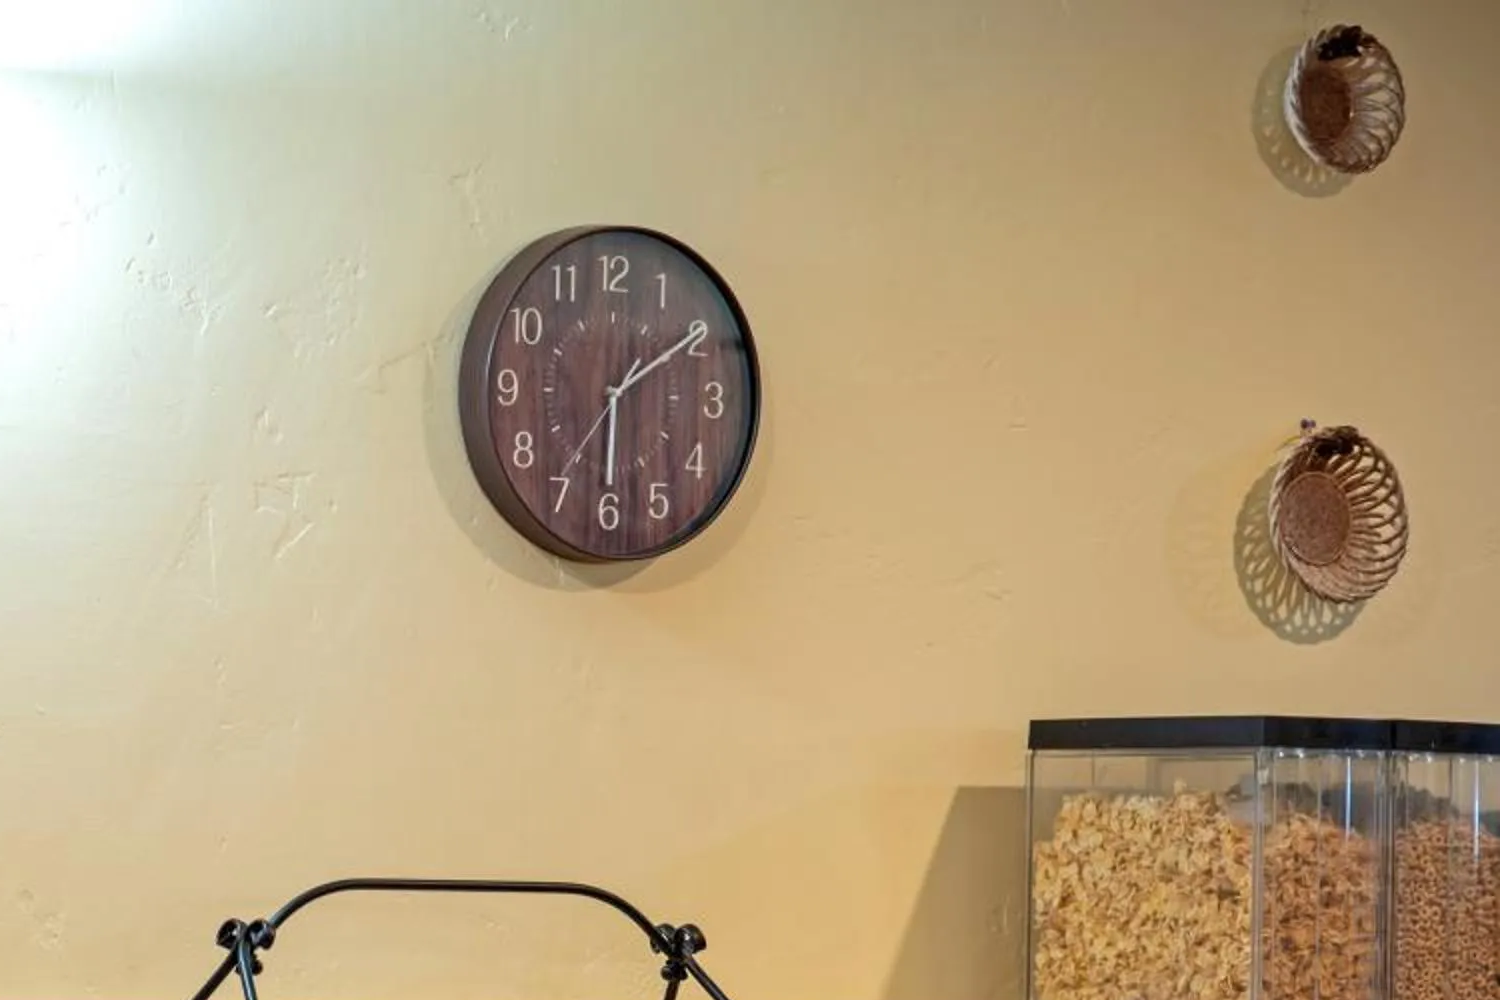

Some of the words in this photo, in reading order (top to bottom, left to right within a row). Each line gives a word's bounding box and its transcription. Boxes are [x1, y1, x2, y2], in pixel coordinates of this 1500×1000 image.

[551, 265, 577, 302] 11
[598, 256, 630, 293] 12
[656, 273, 667, 309] 1
[511, 307, 543, 345] 10
[687, 320, 709, 357] 2
[497, 369, 519, 406] 9
[703, 382, 724, 419] 3
[513, 431, 534, 469] 8
[685, 442, 707, 480] 4
[549, 476, 571, 514] 7
[598, 493, 620, 531] 6
[649, 483, 670, 520] 5
